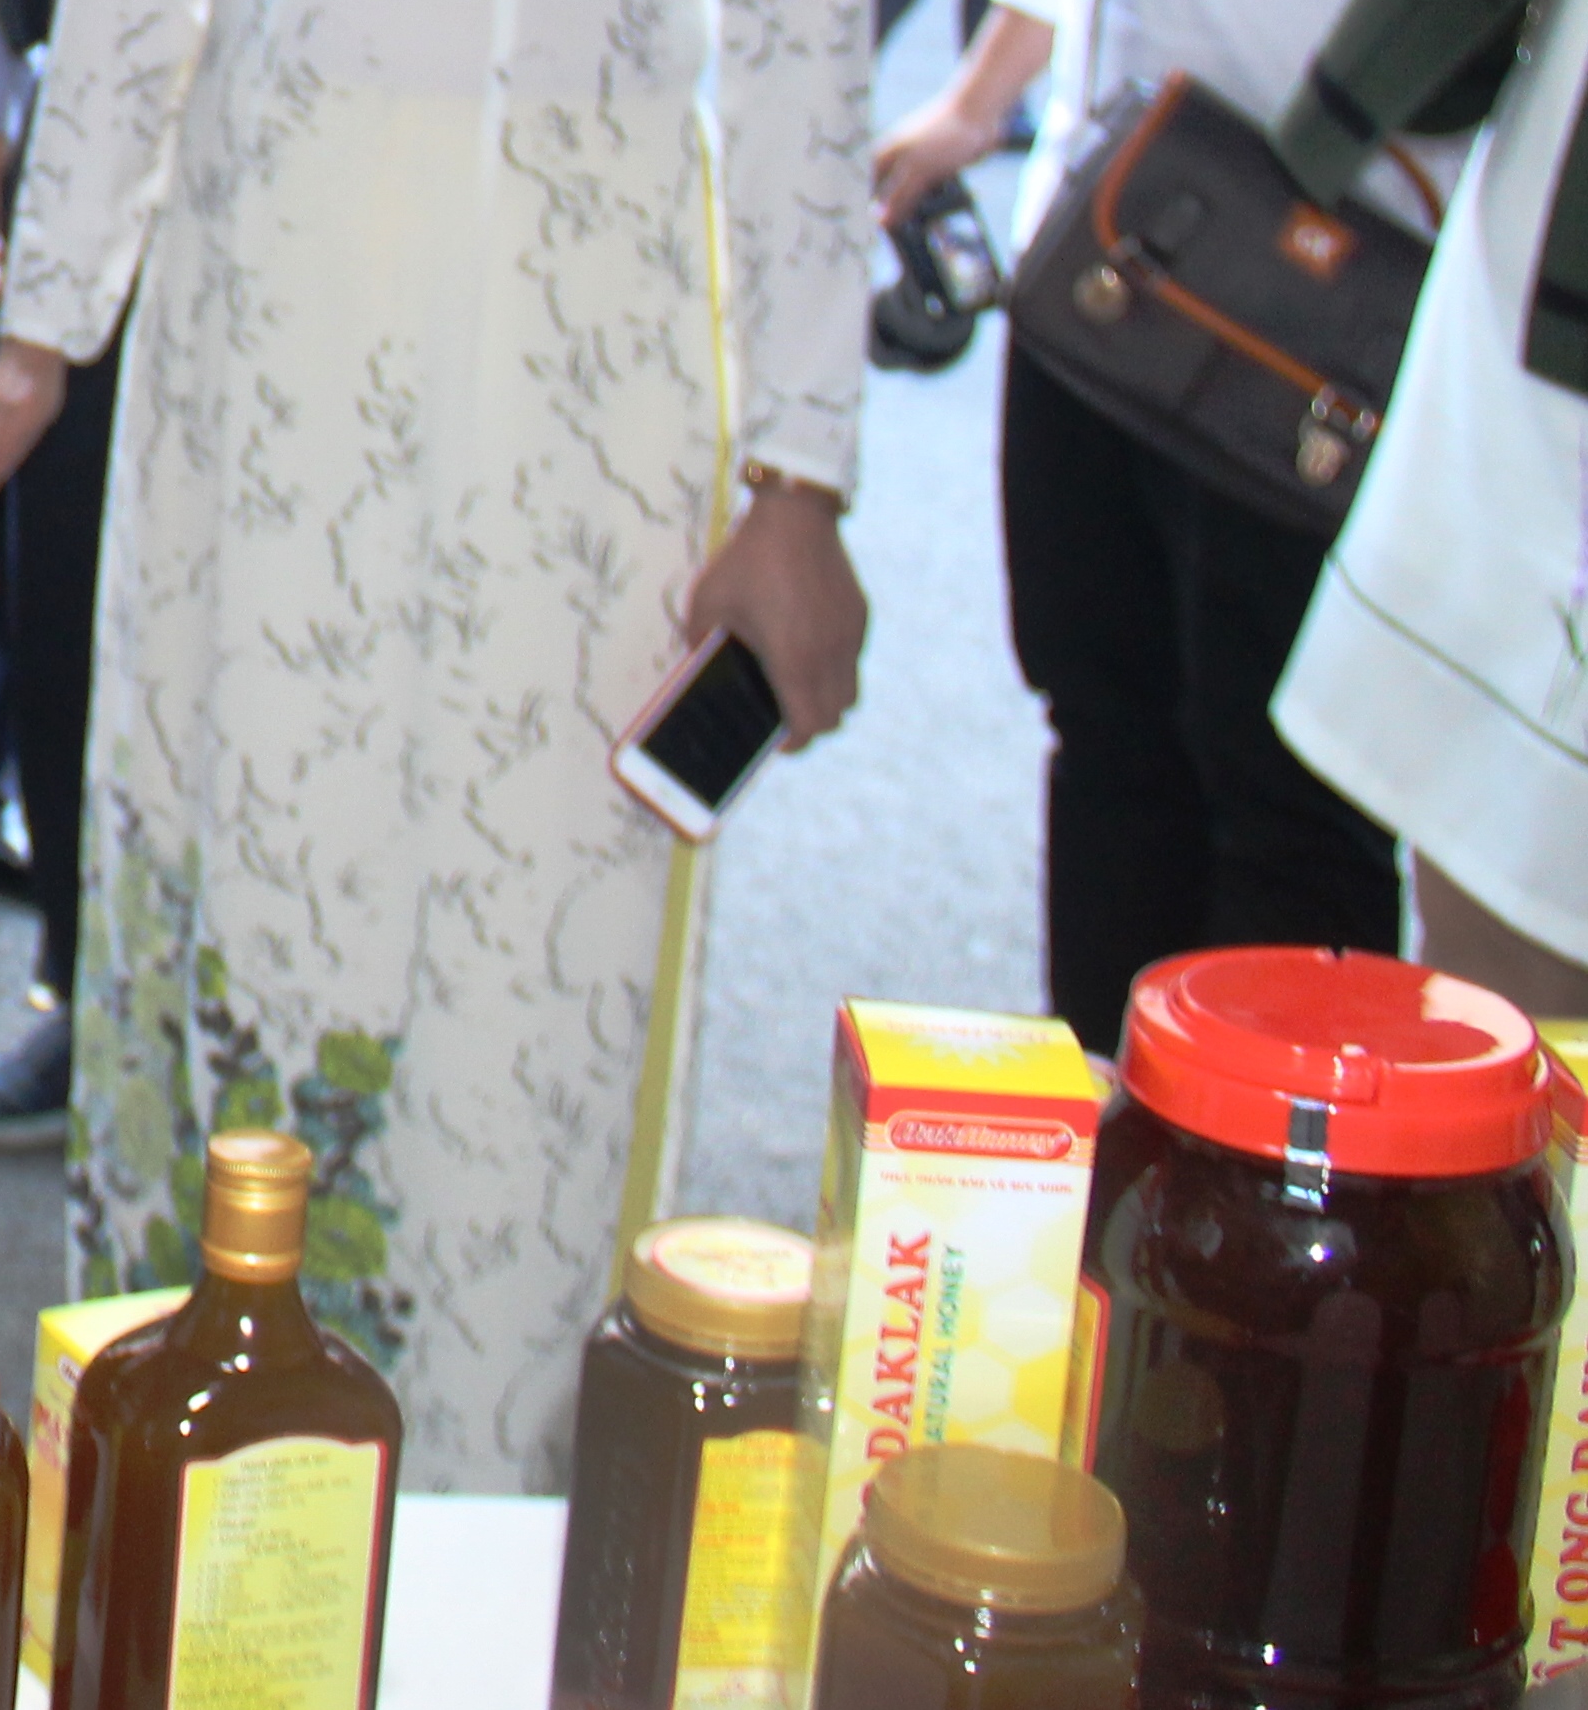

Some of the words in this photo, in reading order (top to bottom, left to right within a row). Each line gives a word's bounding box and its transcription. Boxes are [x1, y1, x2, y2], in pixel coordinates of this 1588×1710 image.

[937, 1242, 966, 1339] HONEY
[864, 1229, 932, 1462] DAKLAK
[924, 1345, 954, 1445] ATURAL
